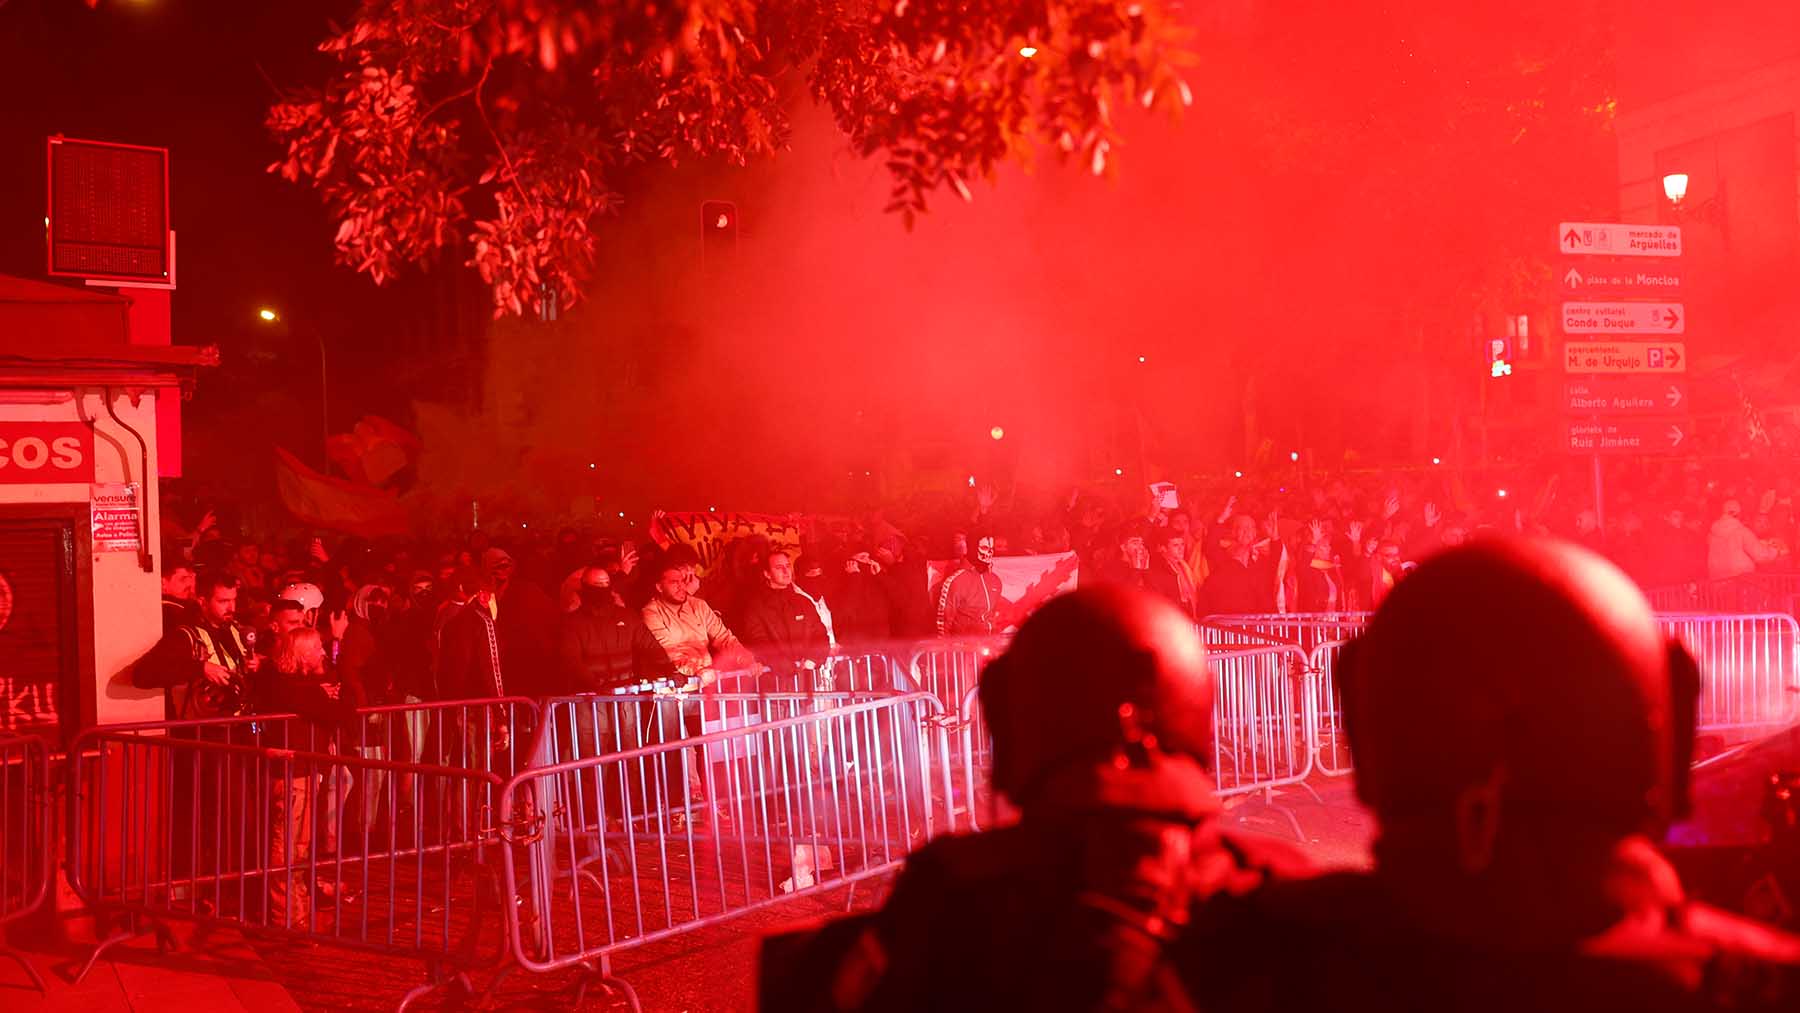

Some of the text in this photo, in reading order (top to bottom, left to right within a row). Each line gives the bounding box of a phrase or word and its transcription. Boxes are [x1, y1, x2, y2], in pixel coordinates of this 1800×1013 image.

[1636, 273, 1680, 286] Moncloa
[1566, 317, 1635, 329] Conde Duque
[1585, 356, 1598, 367] de
[1603, 355, 1641, 368] Urquijo
[1571, 397, 1654, 409] Alberto Aguilera
[1571, 436, 1641, 448] Ruiz Jiménez
[0, 436, 83, 470] OS
[94, 511, 138, 521] Alarma
